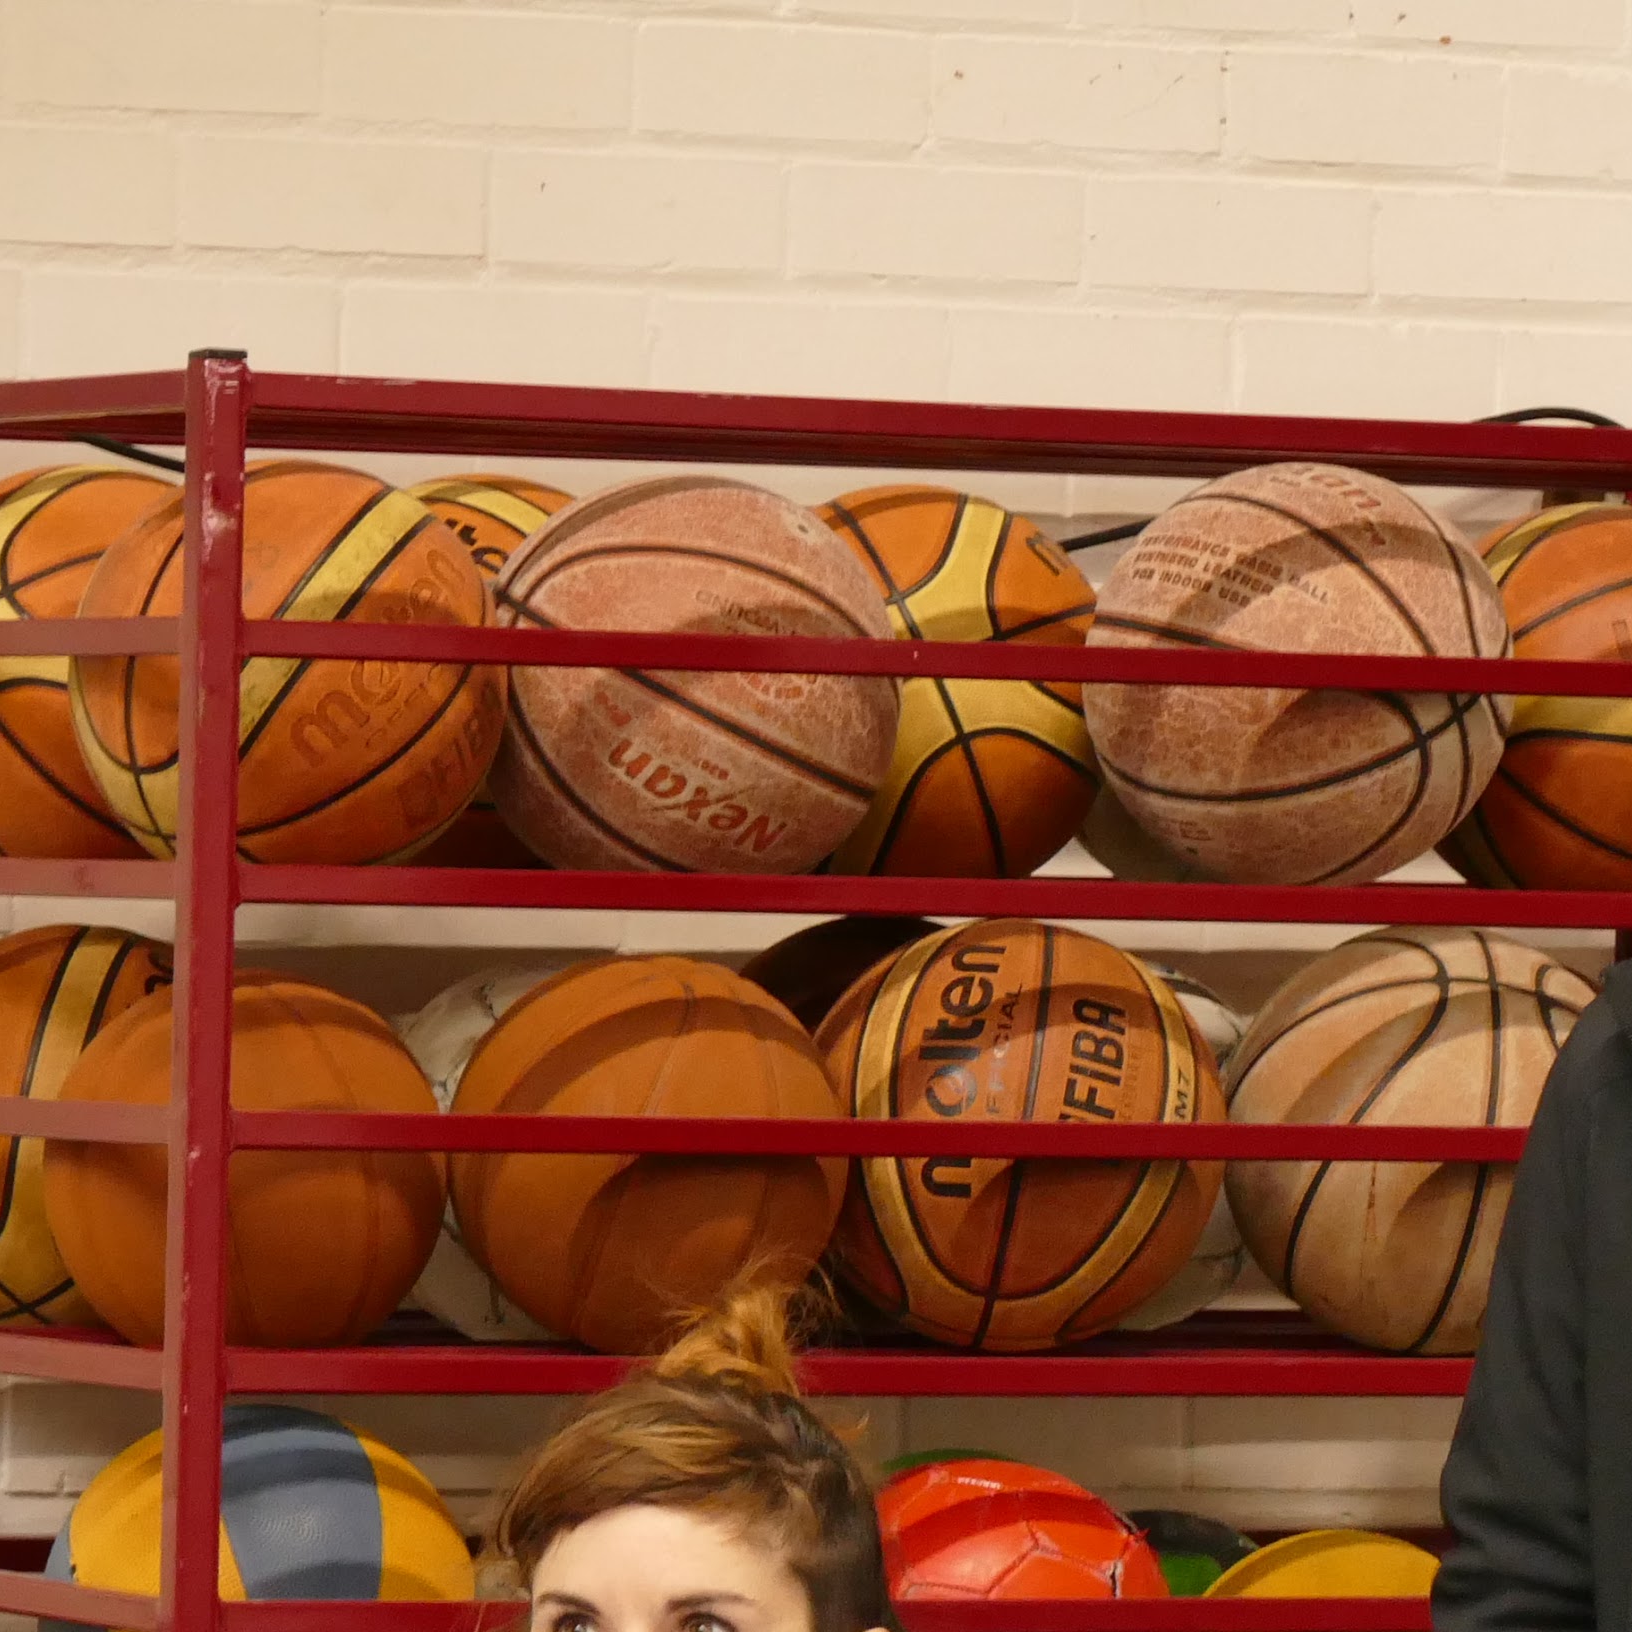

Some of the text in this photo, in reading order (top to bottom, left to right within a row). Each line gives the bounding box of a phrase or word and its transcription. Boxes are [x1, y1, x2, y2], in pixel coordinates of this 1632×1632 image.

[1131, 567, 1156, 582] FOR
[1158, 570, 1213, 593] INDOOR
[1202, 559, 1275, 595] LEATHER
[608, 738, 787, 851] Nexan
[1062, 997, 1127, 1121] FIBA
